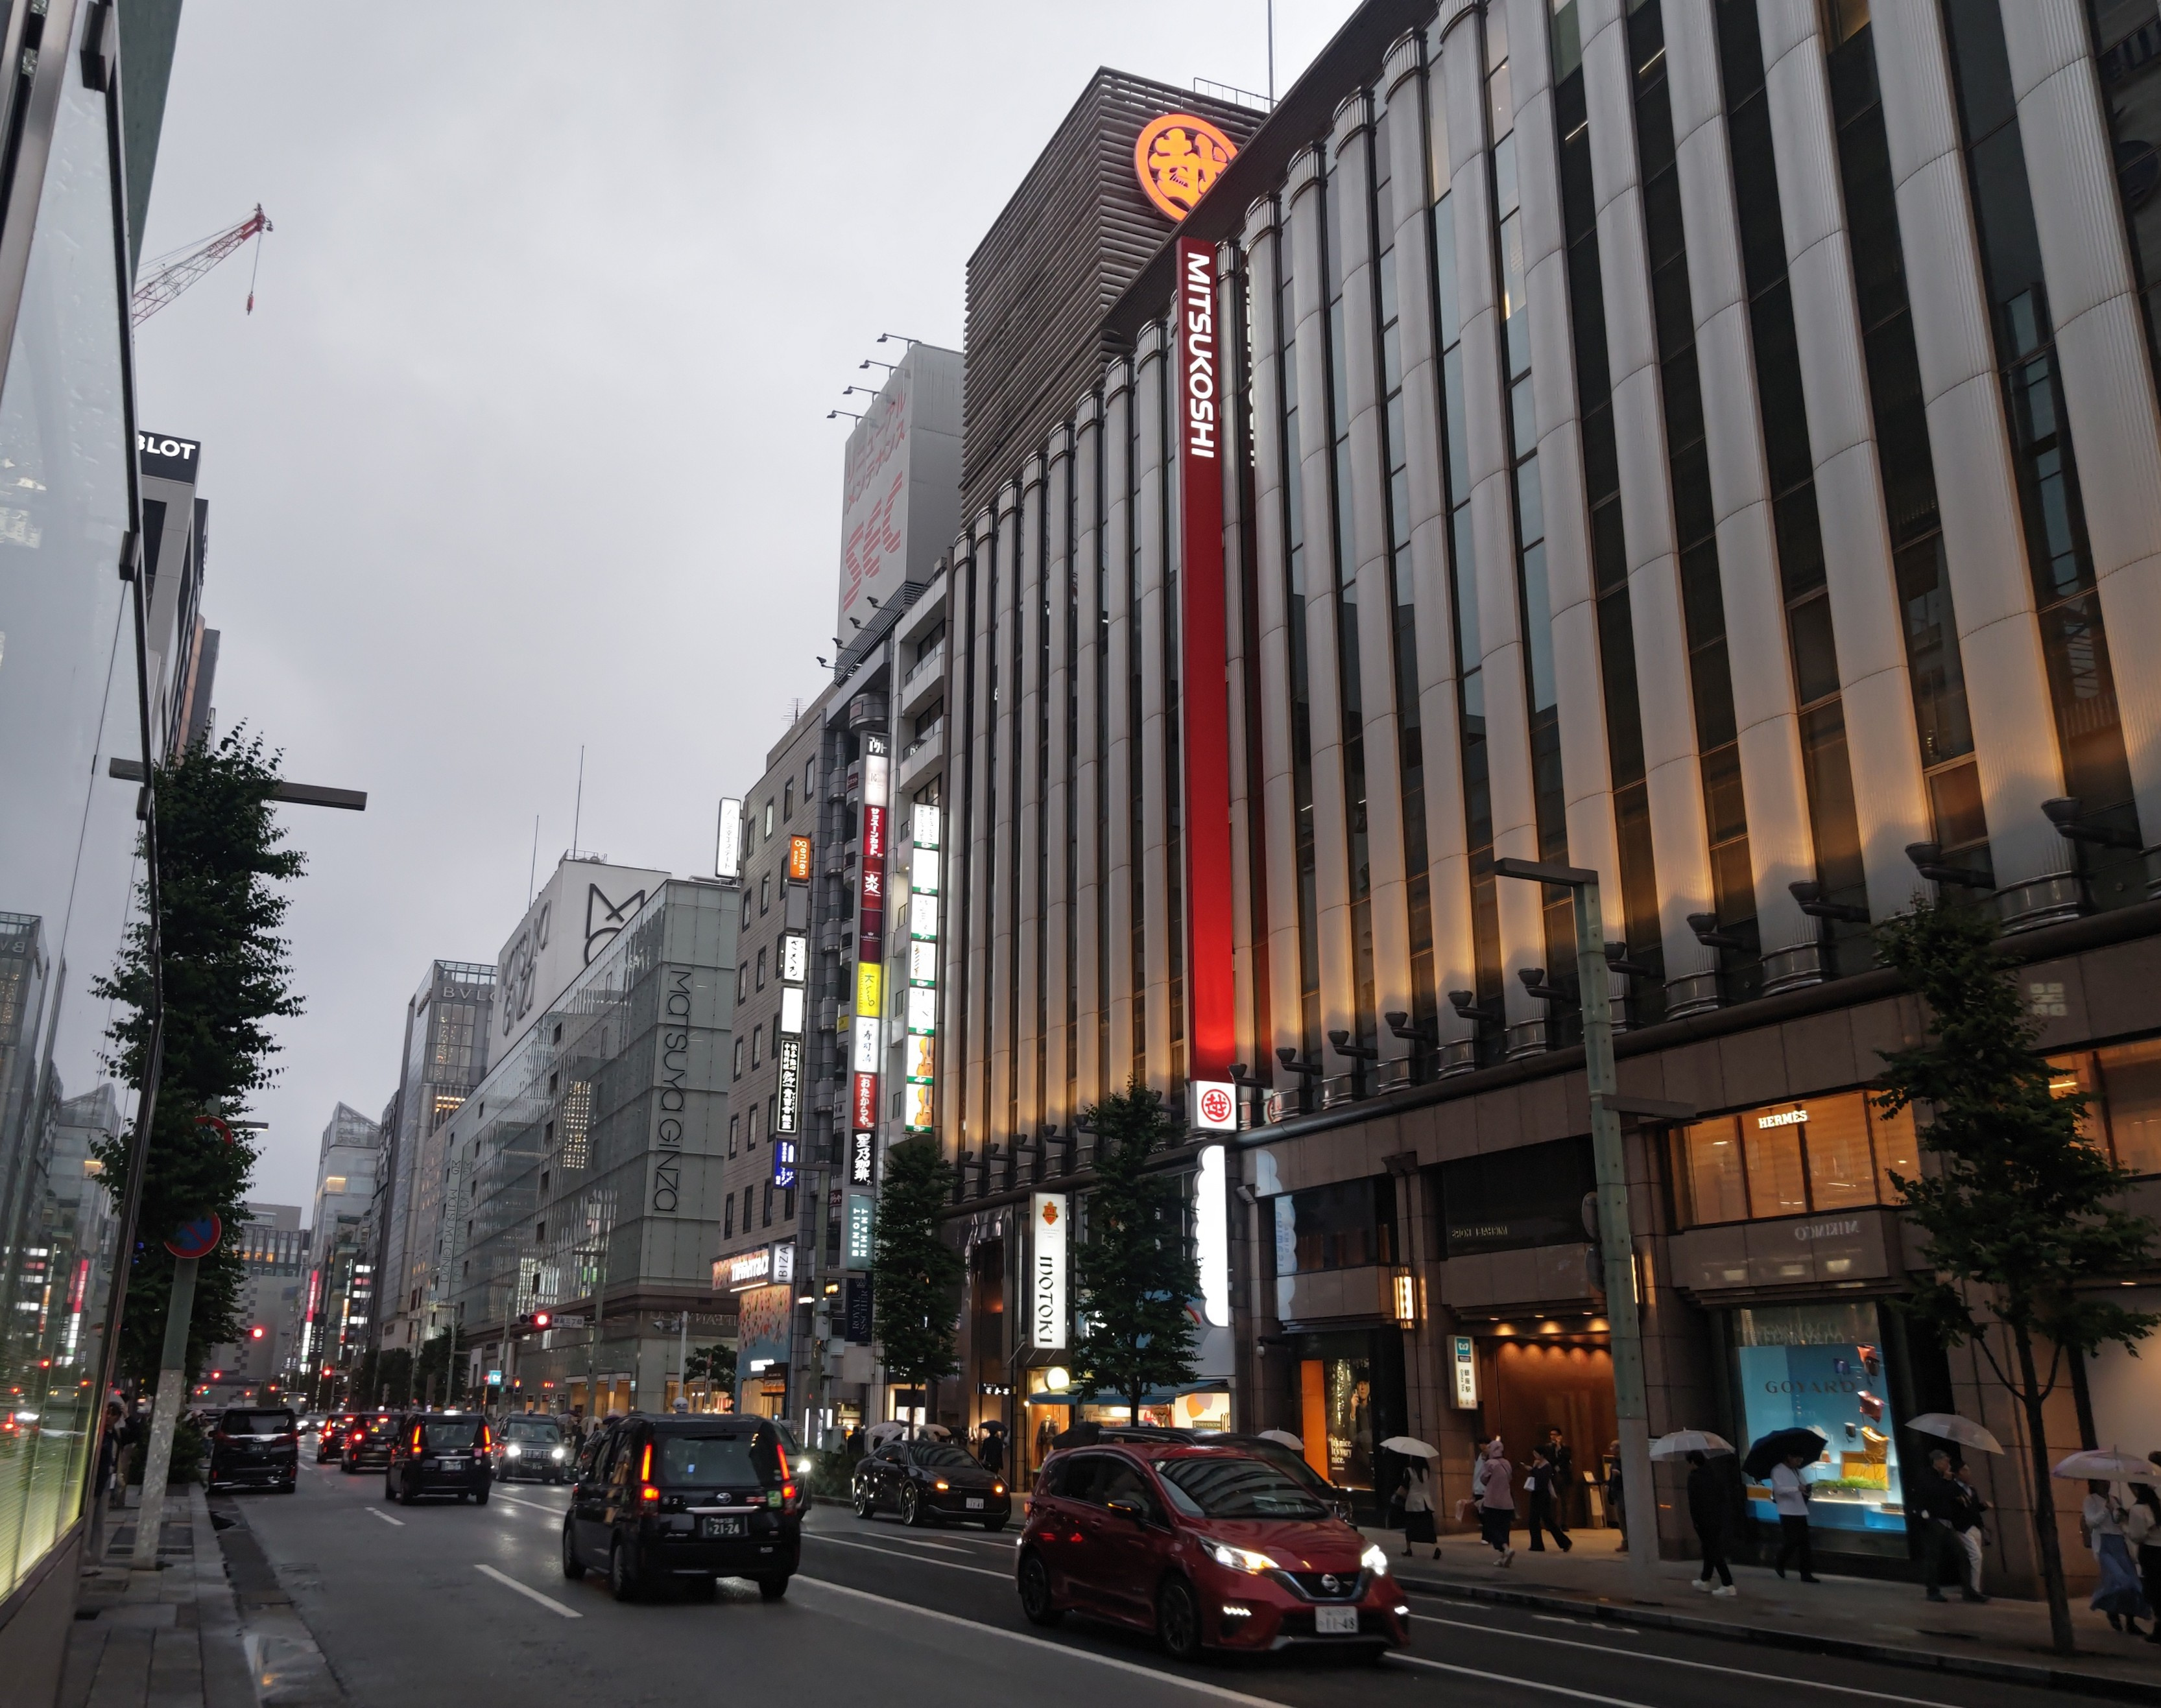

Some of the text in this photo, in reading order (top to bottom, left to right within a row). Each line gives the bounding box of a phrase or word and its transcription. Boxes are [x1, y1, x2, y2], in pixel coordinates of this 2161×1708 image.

[1188, 252, 1215, 458] MITSUKOSHI
[795, 840, 807, 875] genten
[864, 873, 881, 894] 炎
[859, 1078, 870, 1125] おたからや
[852, 1207, 861, 1257] BENOIT
[860, 1208, 868, 1257] NIHANT
[778, 1246, 789, 1283] IBIZA
[852, 1298, 861, 1329] ROYAL
[859, 1290, 868, 1337] ASSCHER
[1038, 1255, 1054, 1343] MOTOKI
[1765, 1379, 1857, 1395] GOYARD
[713, 1524, 740, 1535] 21-24
